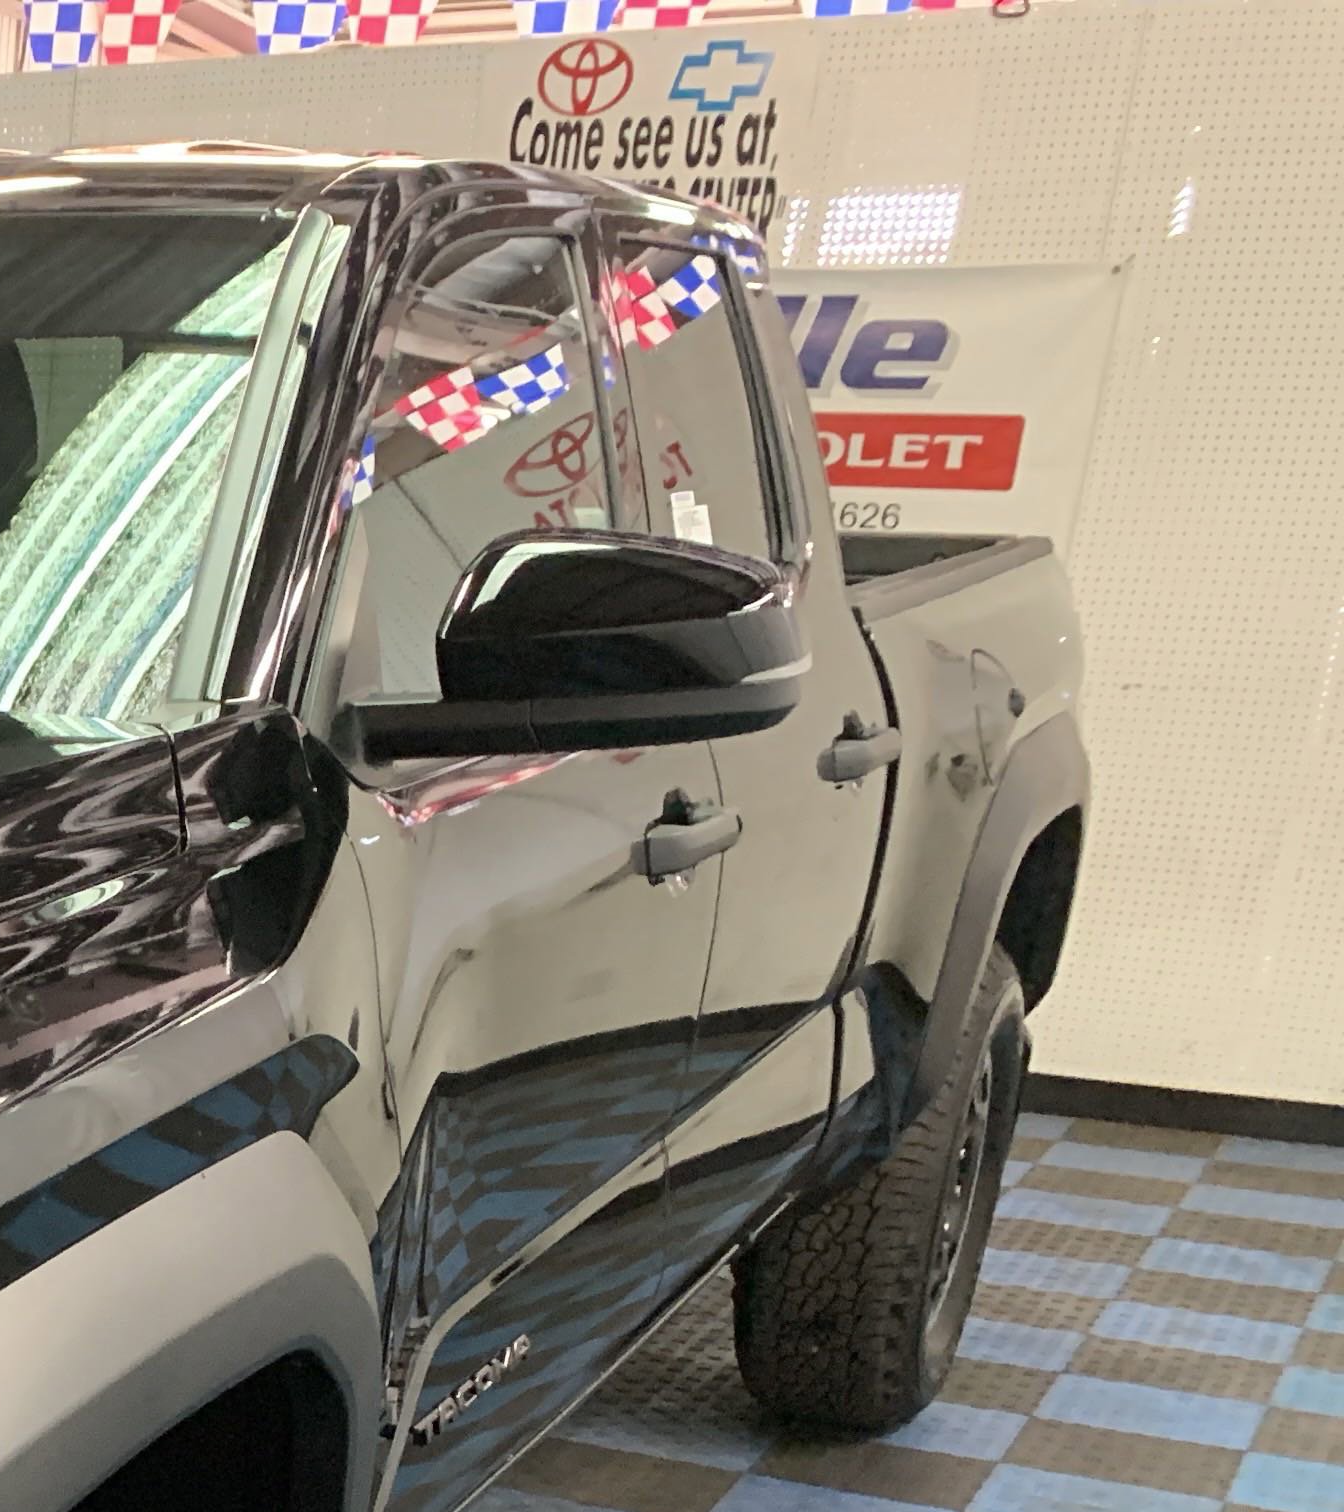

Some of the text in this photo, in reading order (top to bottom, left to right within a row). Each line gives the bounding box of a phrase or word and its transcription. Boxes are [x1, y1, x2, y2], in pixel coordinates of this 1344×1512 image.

[510, 97, 603, 170] Come
[614, 115, 673, 170] see
[686, 114, 726, 168] us
